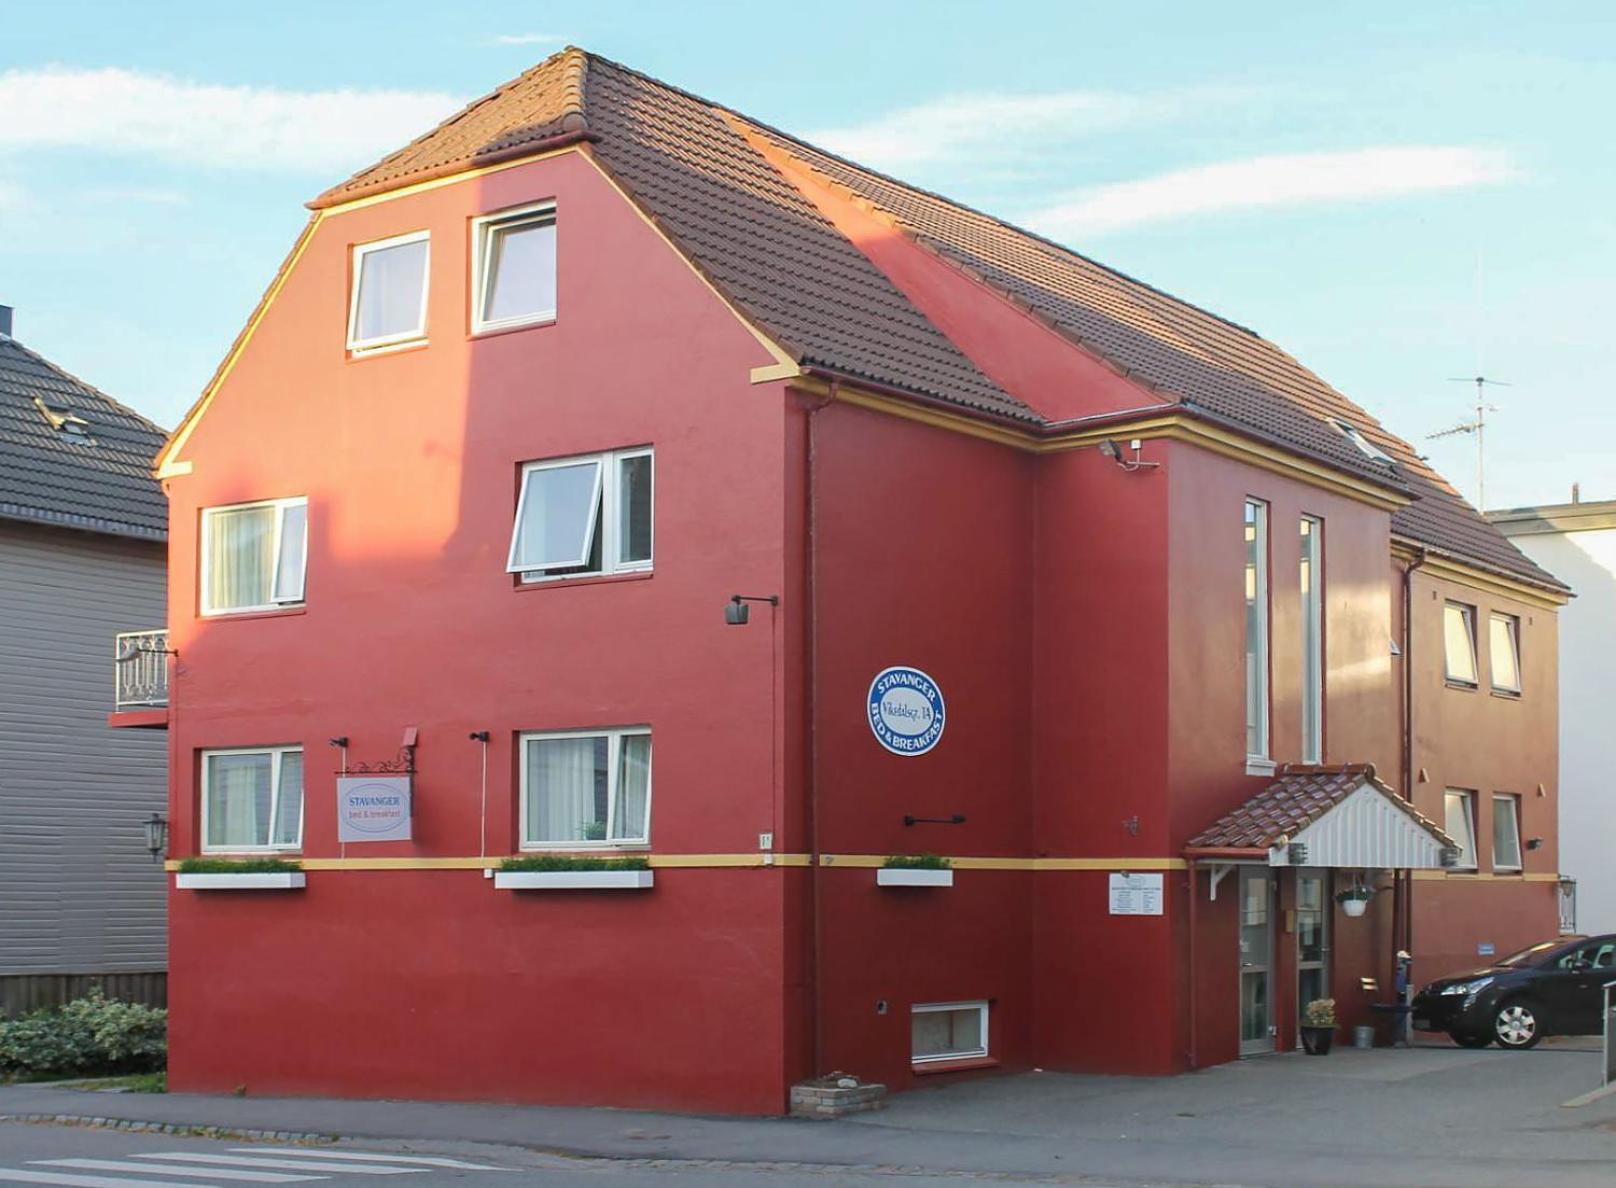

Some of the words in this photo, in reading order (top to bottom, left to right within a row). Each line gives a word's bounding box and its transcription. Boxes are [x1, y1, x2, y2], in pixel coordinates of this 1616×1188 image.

[877, 673, 936, 701] STAVANGER
[871, 702, 886, 735] BED
[892, 710, 942, 750] BREAKFAST
[350, 797, 400, 806] STAVANGER
